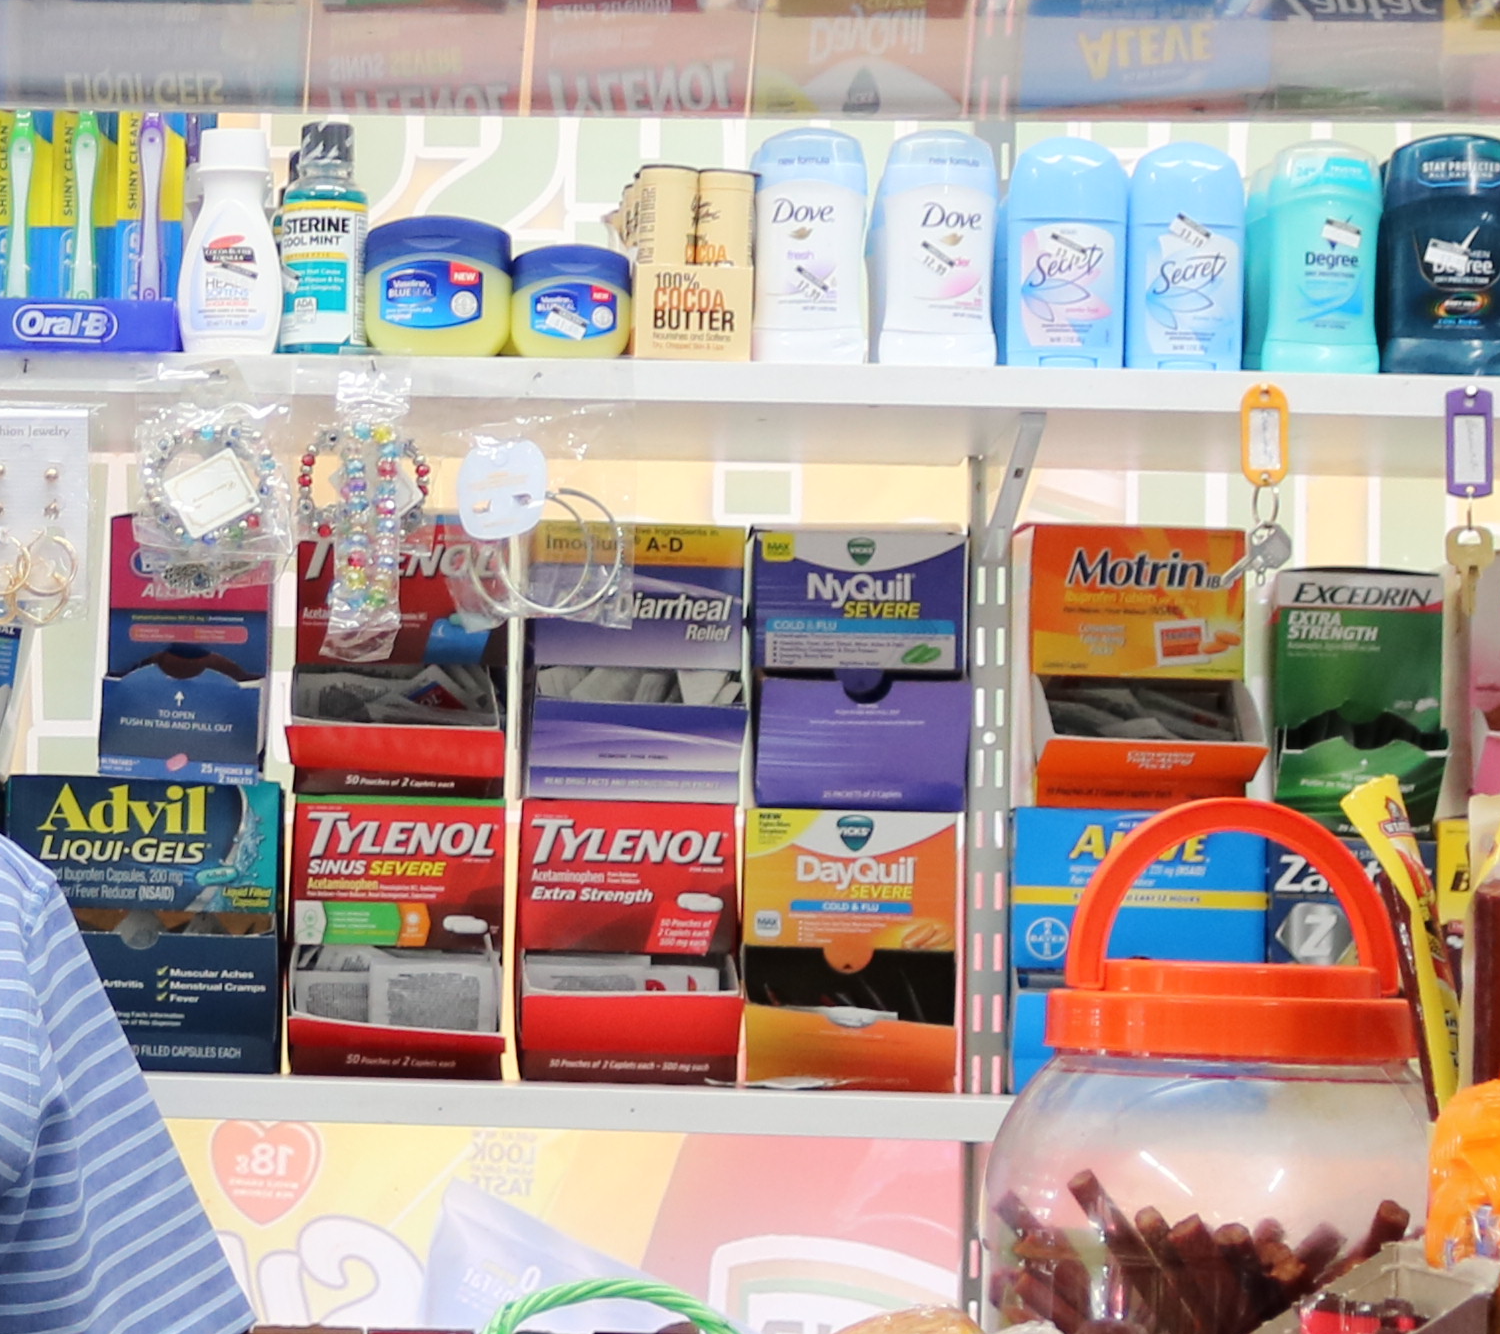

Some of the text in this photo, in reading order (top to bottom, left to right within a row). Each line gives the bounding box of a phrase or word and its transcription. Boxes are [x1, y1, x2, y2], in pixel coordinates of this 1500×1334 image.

[771, 201, 834, 224] Dove
[1159, 253, 1227, 294] Secret
[1305, 250, 1359, 269] Degree
[654, 271, 700, 291] 100%
[654, 288, 725, 311] COCOA
[20, 309, 111, 338] Oral-B
[653, 309, 734, 332] BUTTER
[1068, 548, 1209, 588] Motrin
[806, 574, 916, 604] NyQuil
[1292, 582, 1434, 606] EXCEDRIN
[38, 784, 209, 835] Advil
[307, 811, 499, 858] TYLENOL
[796, 855, 917, 885] DayQuil
